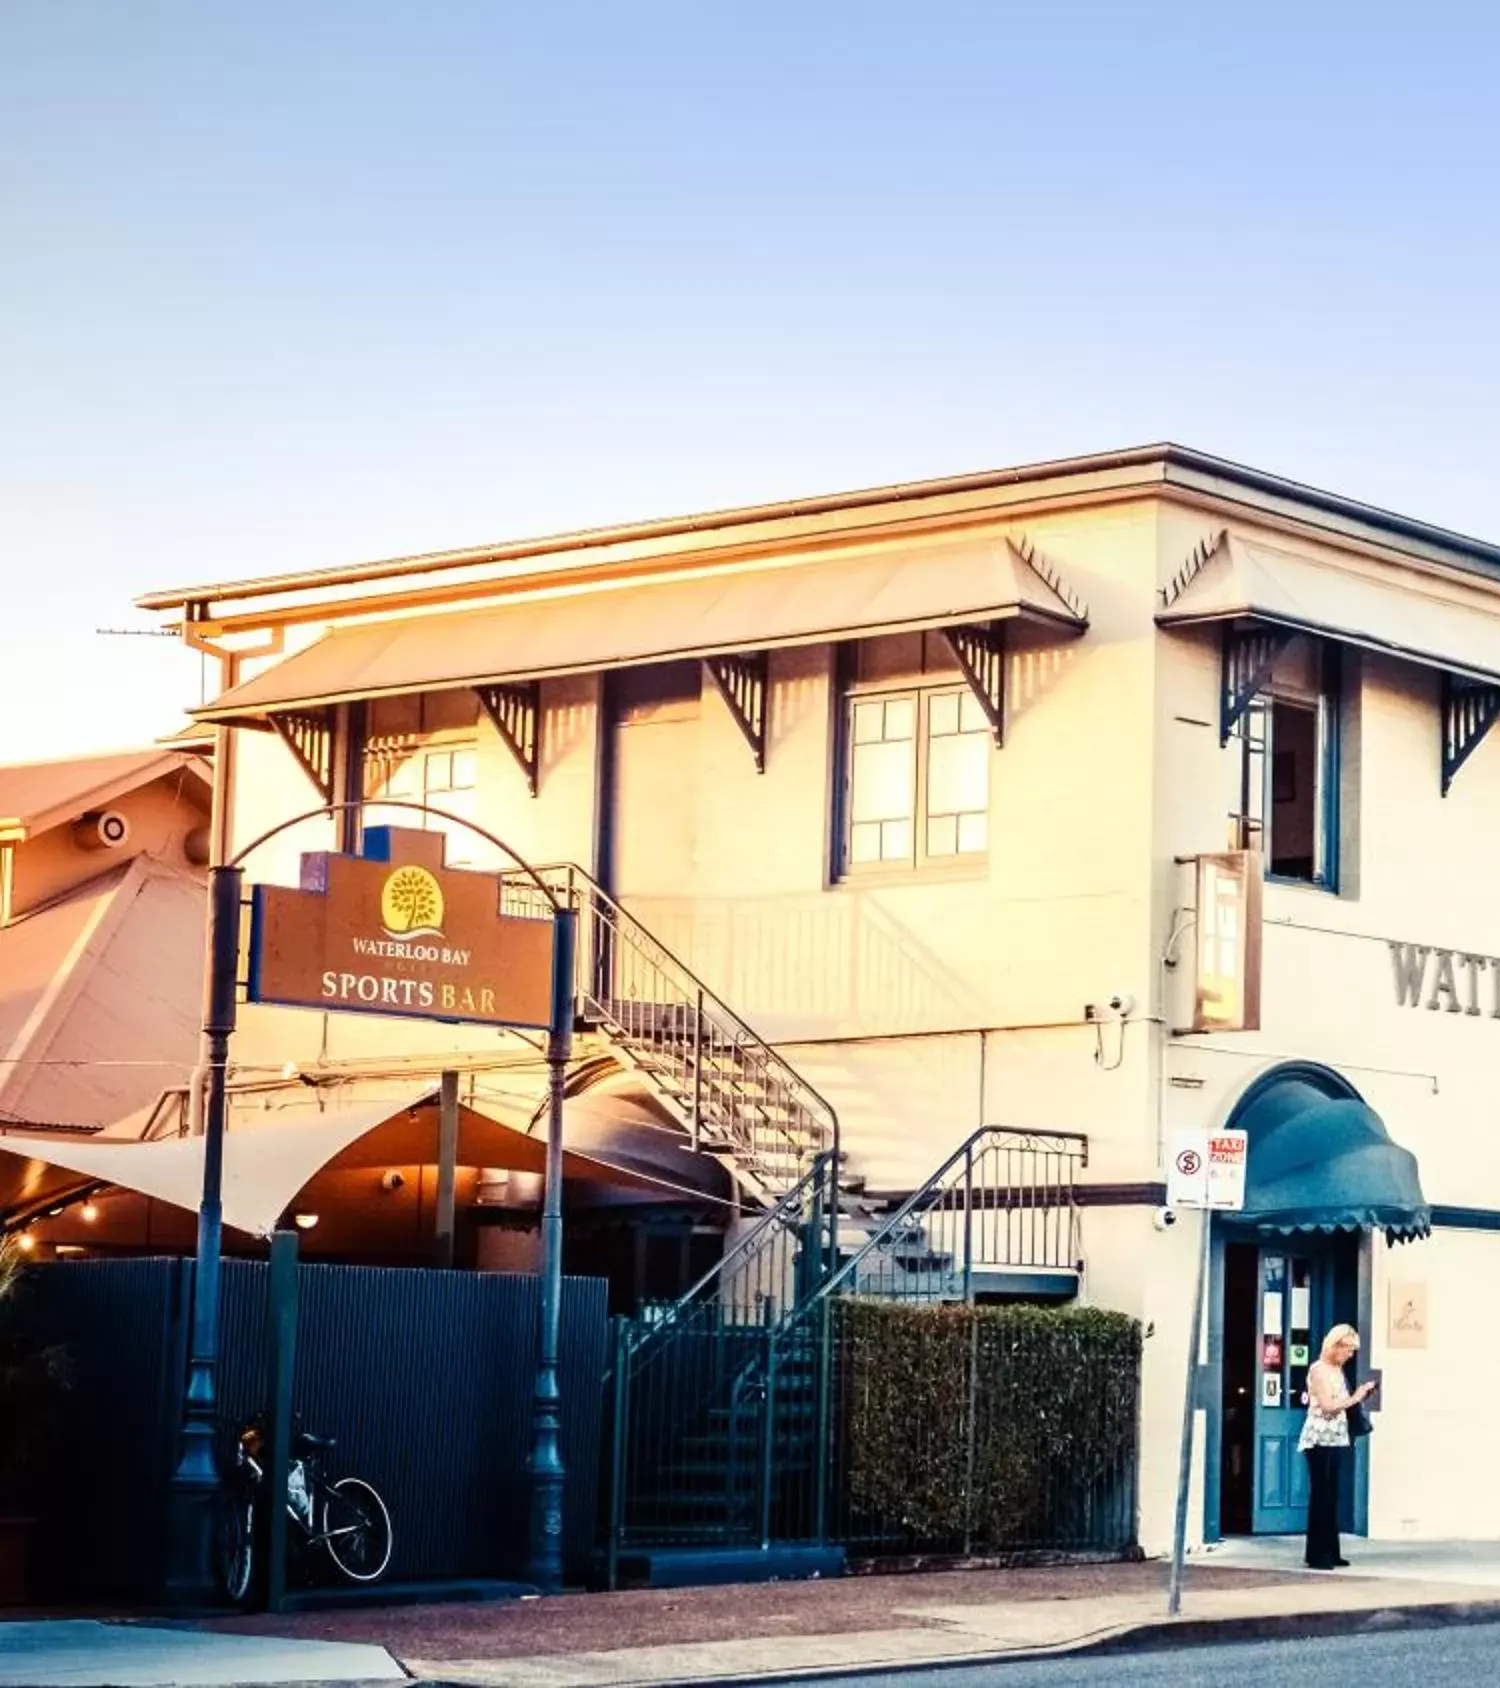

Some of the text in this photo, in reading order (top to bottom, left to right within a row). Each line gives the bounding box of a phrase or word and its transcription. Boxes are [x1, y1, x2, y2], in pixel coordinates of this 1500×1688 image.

[352, 938, 471, 966] WATERLOO BAY
[321, 971, 496, 1013] SPORTS BAR
[1211, 1138, 1243, 1152] TAXI
